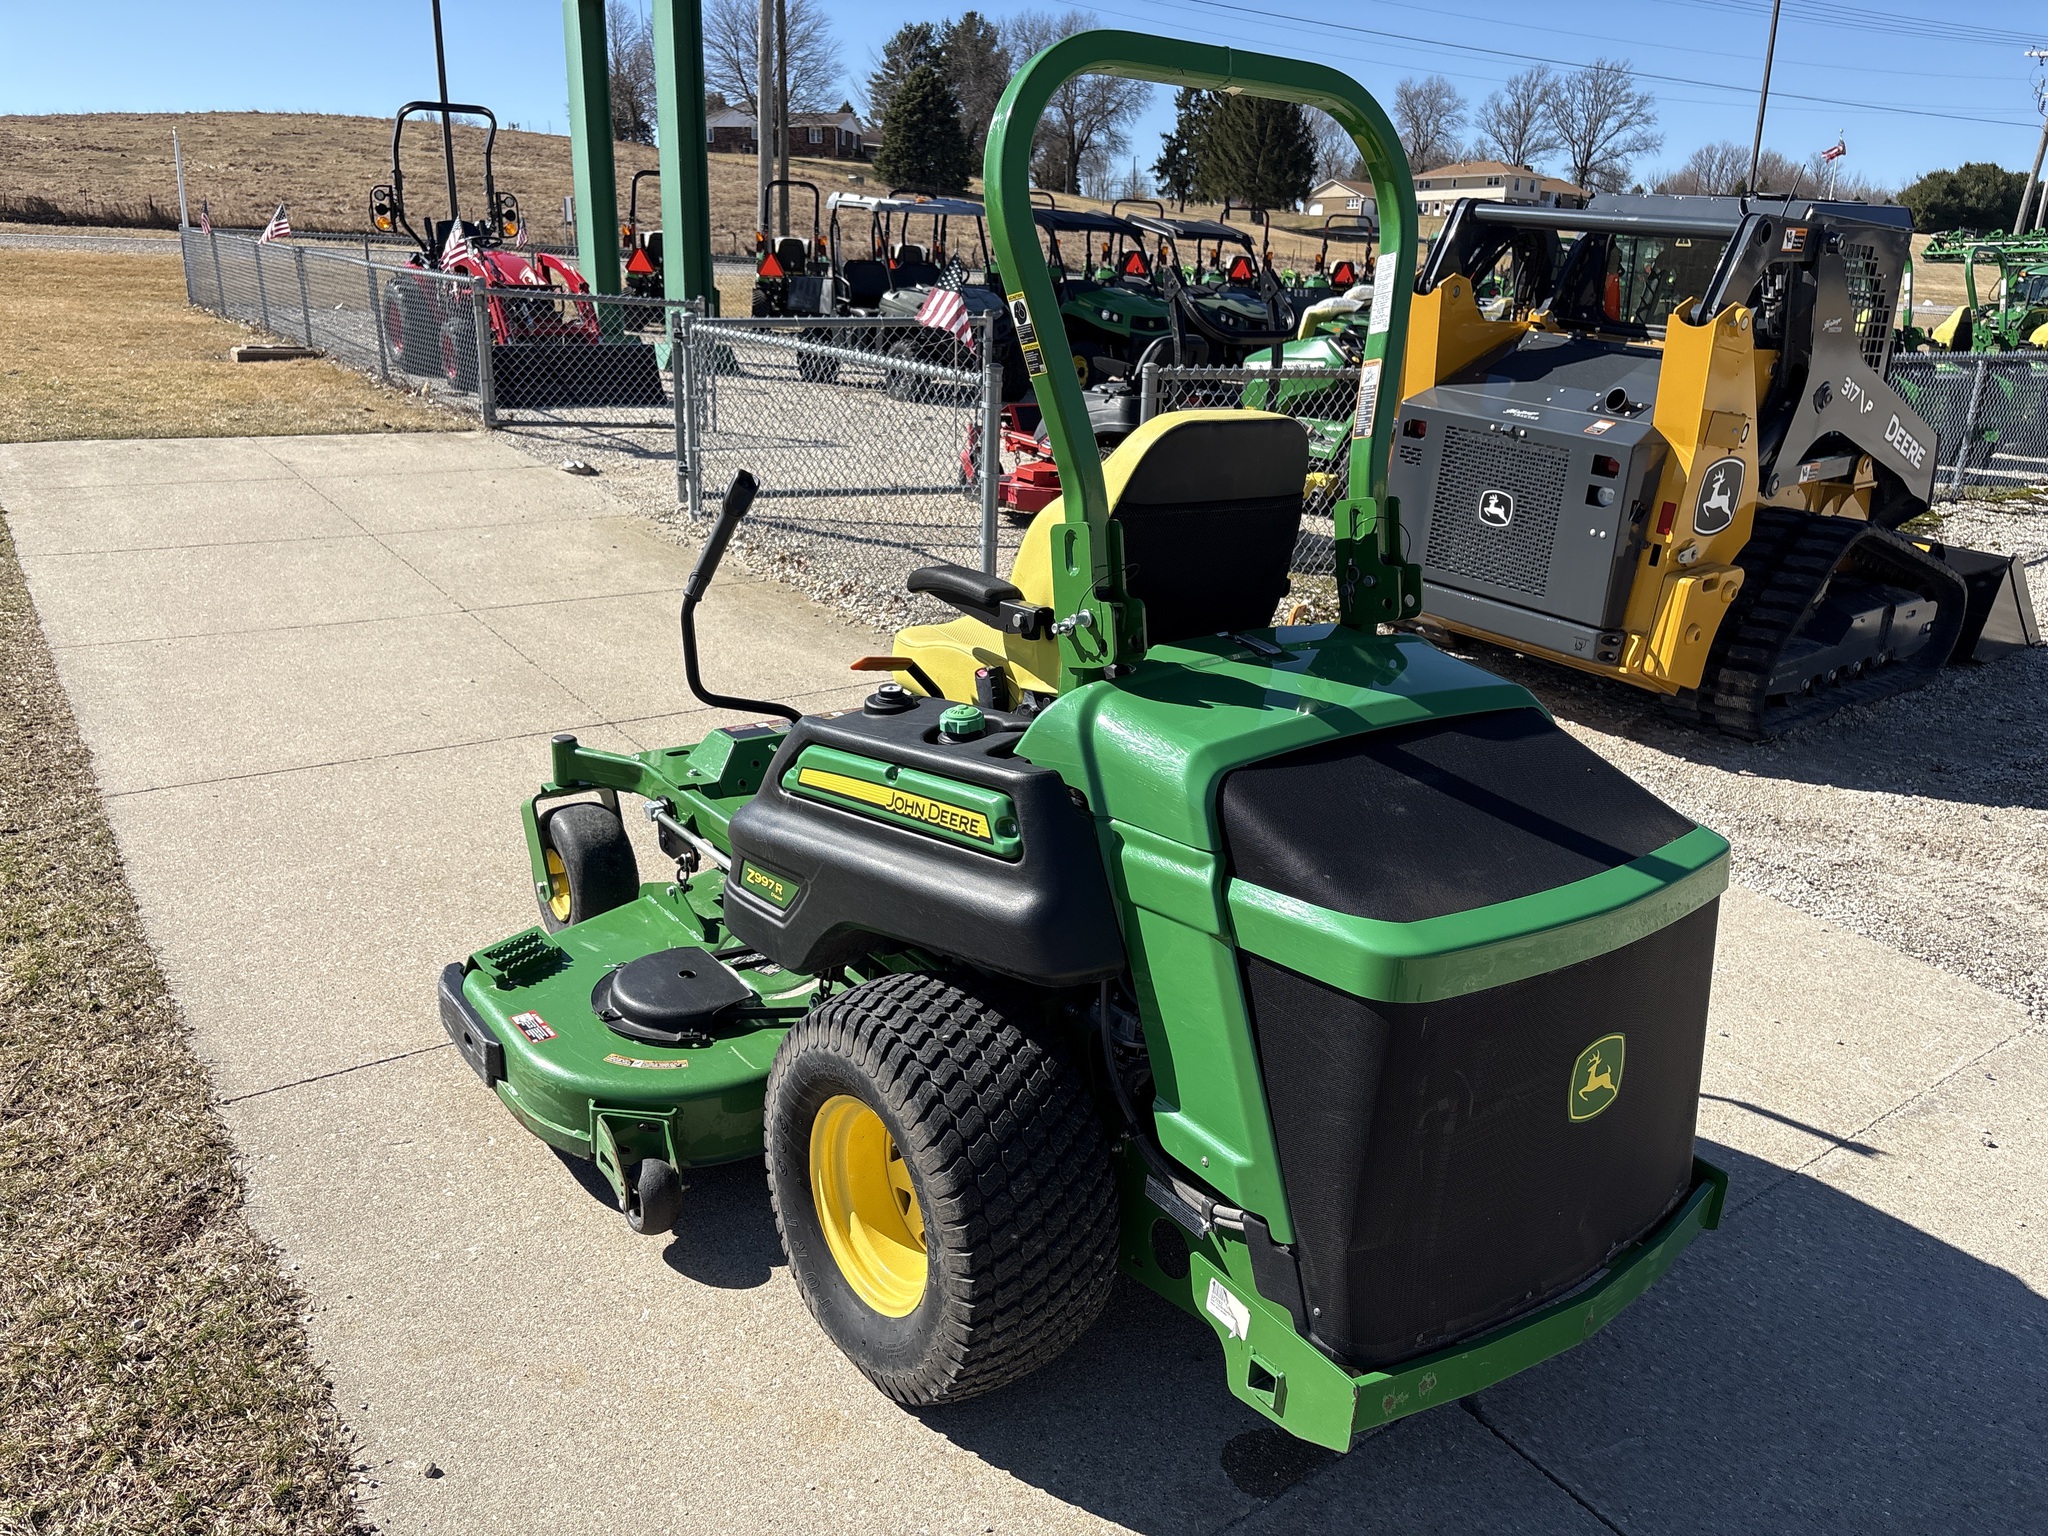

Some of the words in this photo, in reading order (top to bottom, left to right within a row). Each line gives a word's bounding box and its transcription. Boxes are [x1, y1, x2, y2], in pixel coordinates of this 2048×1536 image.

[1841, 376, 1861, 402] 317
[1884, 413, 1926, 470] DEERE
[886, 791, 926, 818] JOHN
[928, 803, 981, 834] DEERE
[746, 867, 783, 895] Z997R
[782, 1210, 834, 1316] TURF
